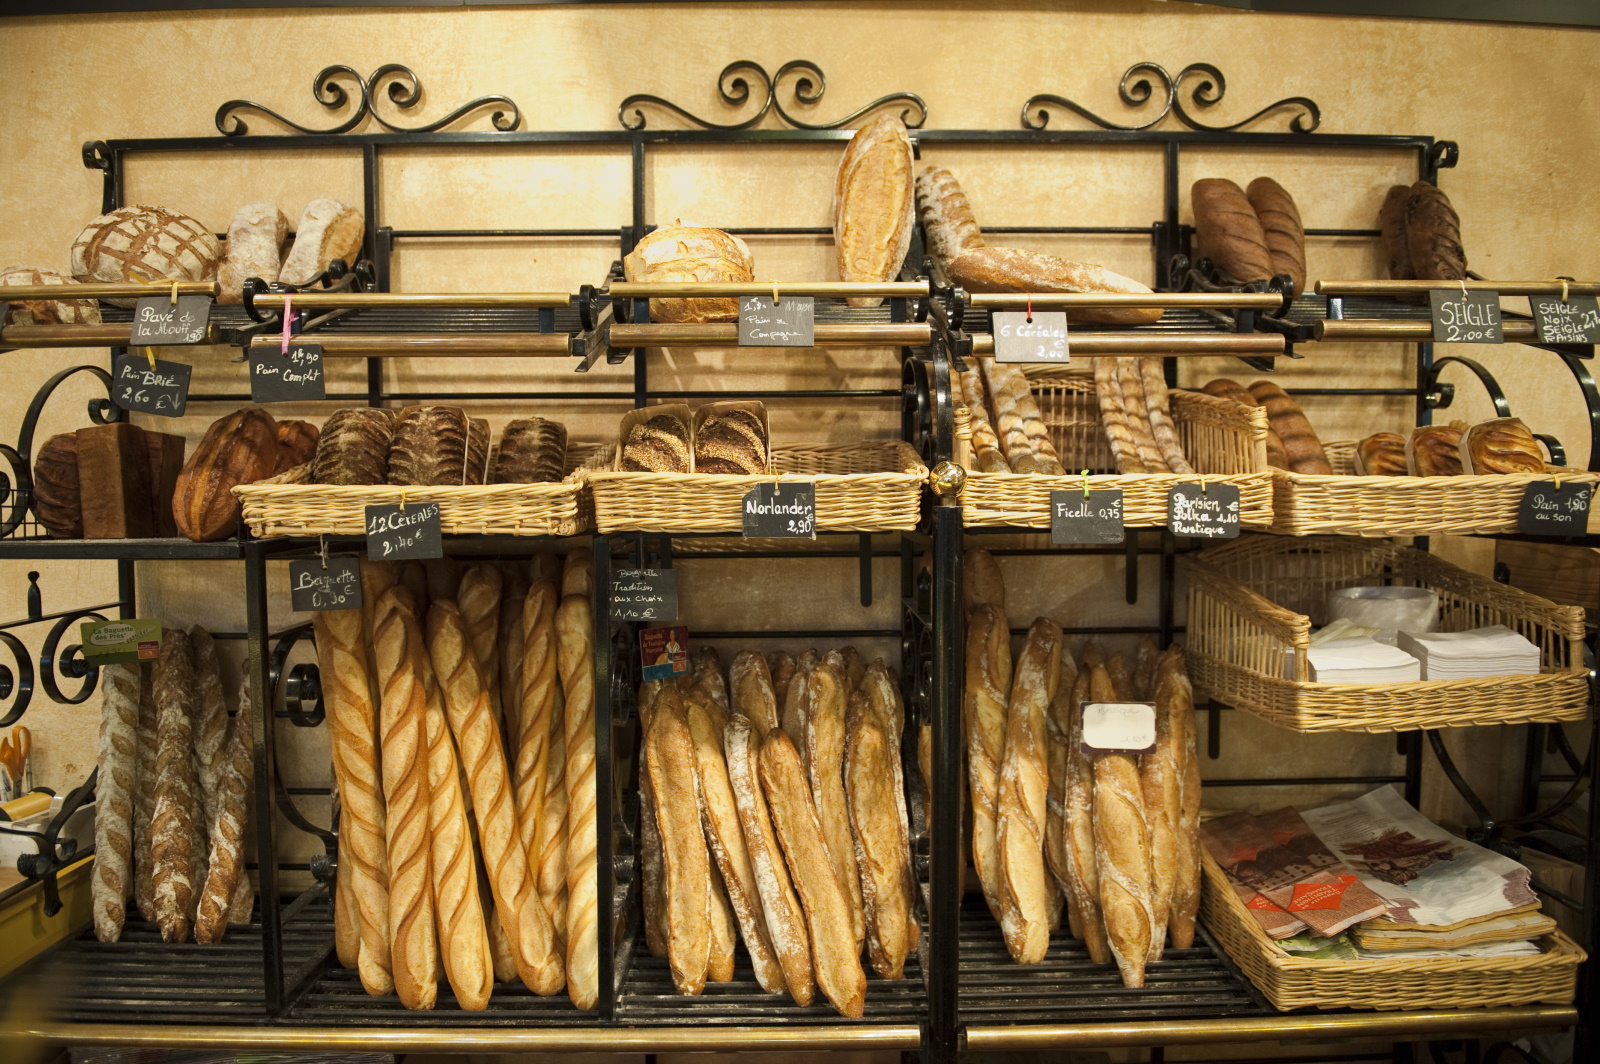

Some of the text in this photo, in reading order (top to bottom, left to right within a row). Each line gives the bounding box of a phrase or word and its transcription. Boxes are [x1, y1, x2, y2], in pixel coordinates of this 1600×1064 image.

[141, 307, 196, 322] Pavé de
[1440, 302, 1498, 326] SEIGLE
[138, 323, 151, 336] la
[1000, 324, 1065, 338] 6 Céréales
[1485, 328, 1495, 339] €
[121, 365, 140, 379] Pain
[256, 364, 321, 385] Pain Complet
[746, 497, 812, 515] Norlander
[1173, 493, 1221, 512] Parisien
[1531, 494, 1559, 510] Pain
[1056, 503, 1094, 517] Ficelle
[1173, 506, 1212, 522] Polka
[1553, 513, 1572, 522] son
[368, 516, 388, 536] 12
[1172, 521, 1225, 538] Rustique
[612, 581, 653, 591] Tradition
